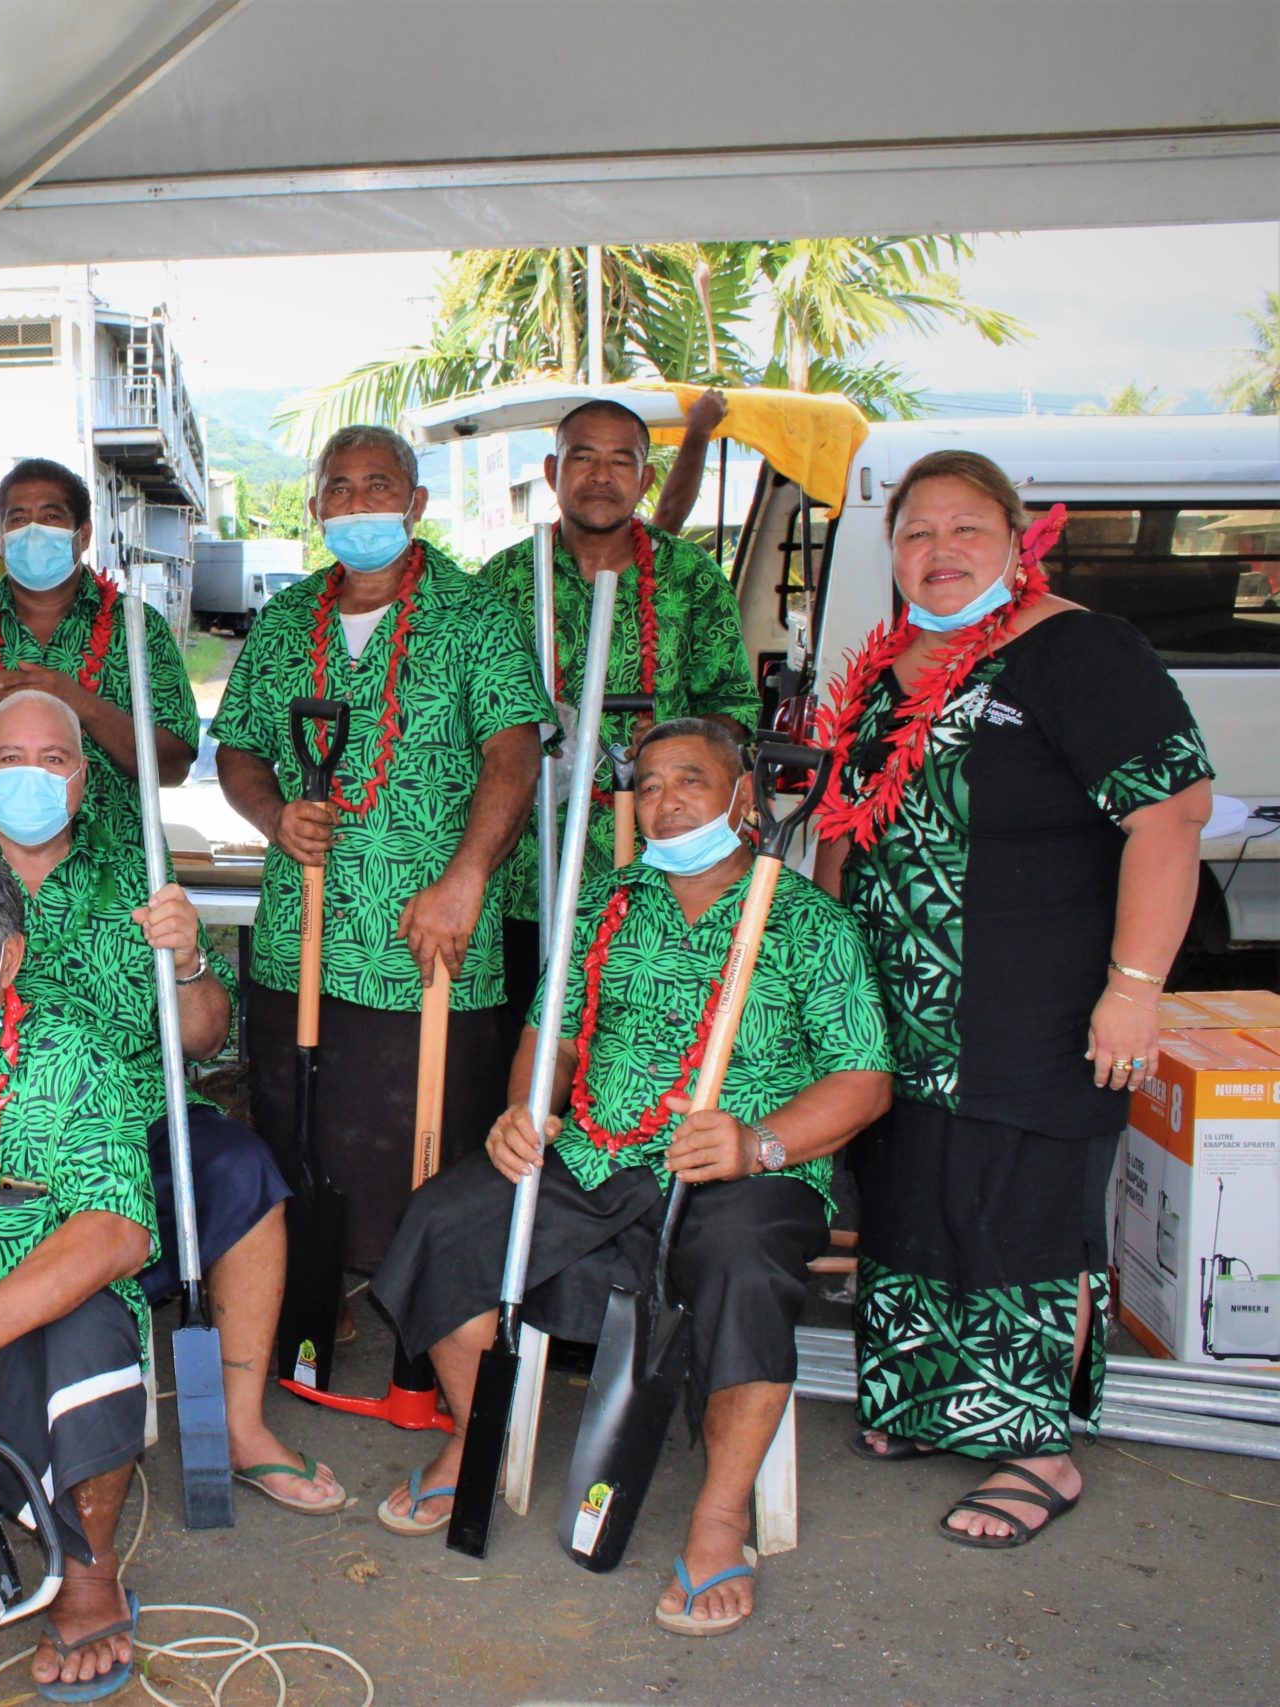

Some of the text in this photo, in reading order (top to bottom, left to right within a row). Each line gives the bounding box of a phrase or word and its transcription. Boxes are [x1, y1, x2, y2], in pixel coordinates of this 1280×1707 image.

[302, 884, 310, 935] TRAMONTINA
[721, 948, 743, 1007] TRAMONTINA
[1139, 1076, 1183, 1134] UMBER 8
[1215, 1084, 1265, 1096] NUMBER
[1231, 1305, 1269, 1313] NUMBER 8
